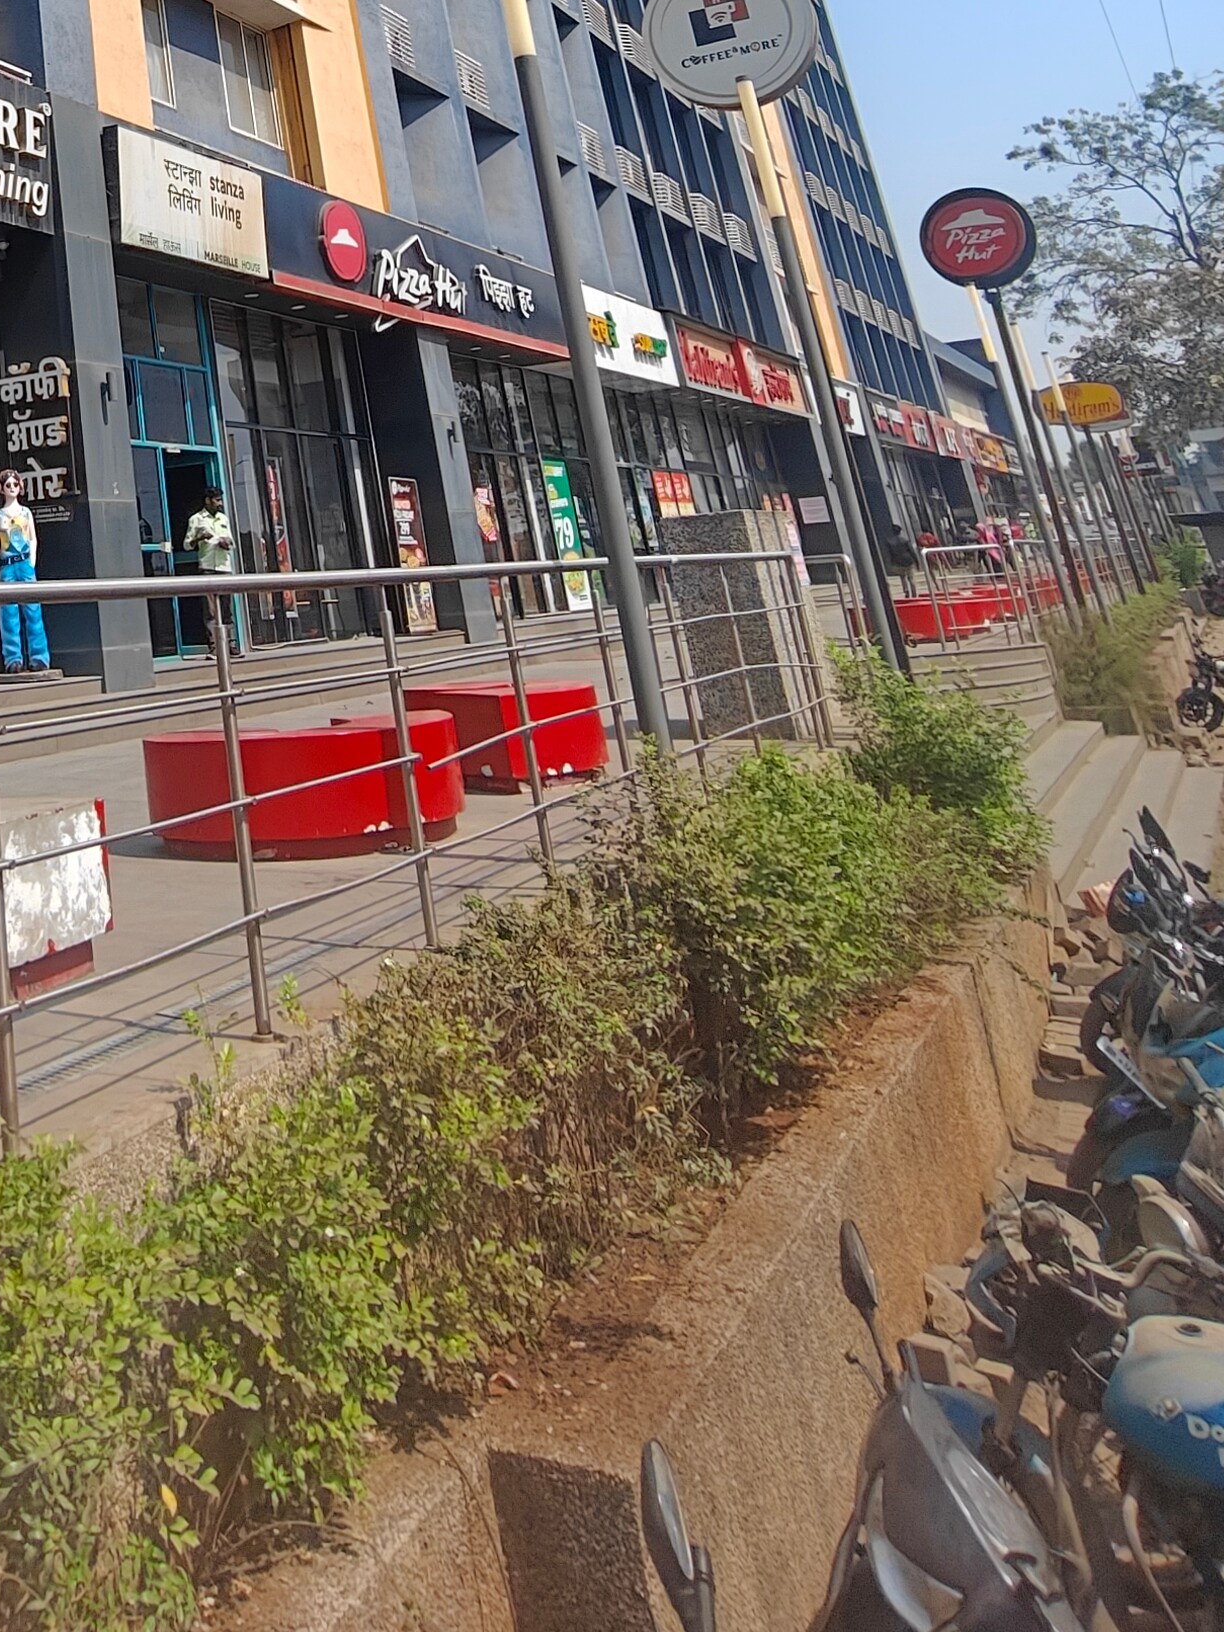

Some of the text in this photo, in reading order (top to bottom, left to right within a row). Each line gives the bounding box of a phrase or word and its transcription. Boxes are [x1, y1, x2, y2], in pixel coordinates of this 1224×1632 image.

[209, 174, 245, 201] stanza
[210, 195, 243, 230] living
[945, 227, 1006, 250] Pizza
[204, 250, 262, 274] MARSEILLE HOUSE
[955, 244, 1002, 264] Hut
[374, 248, 434, 304] Pizza
